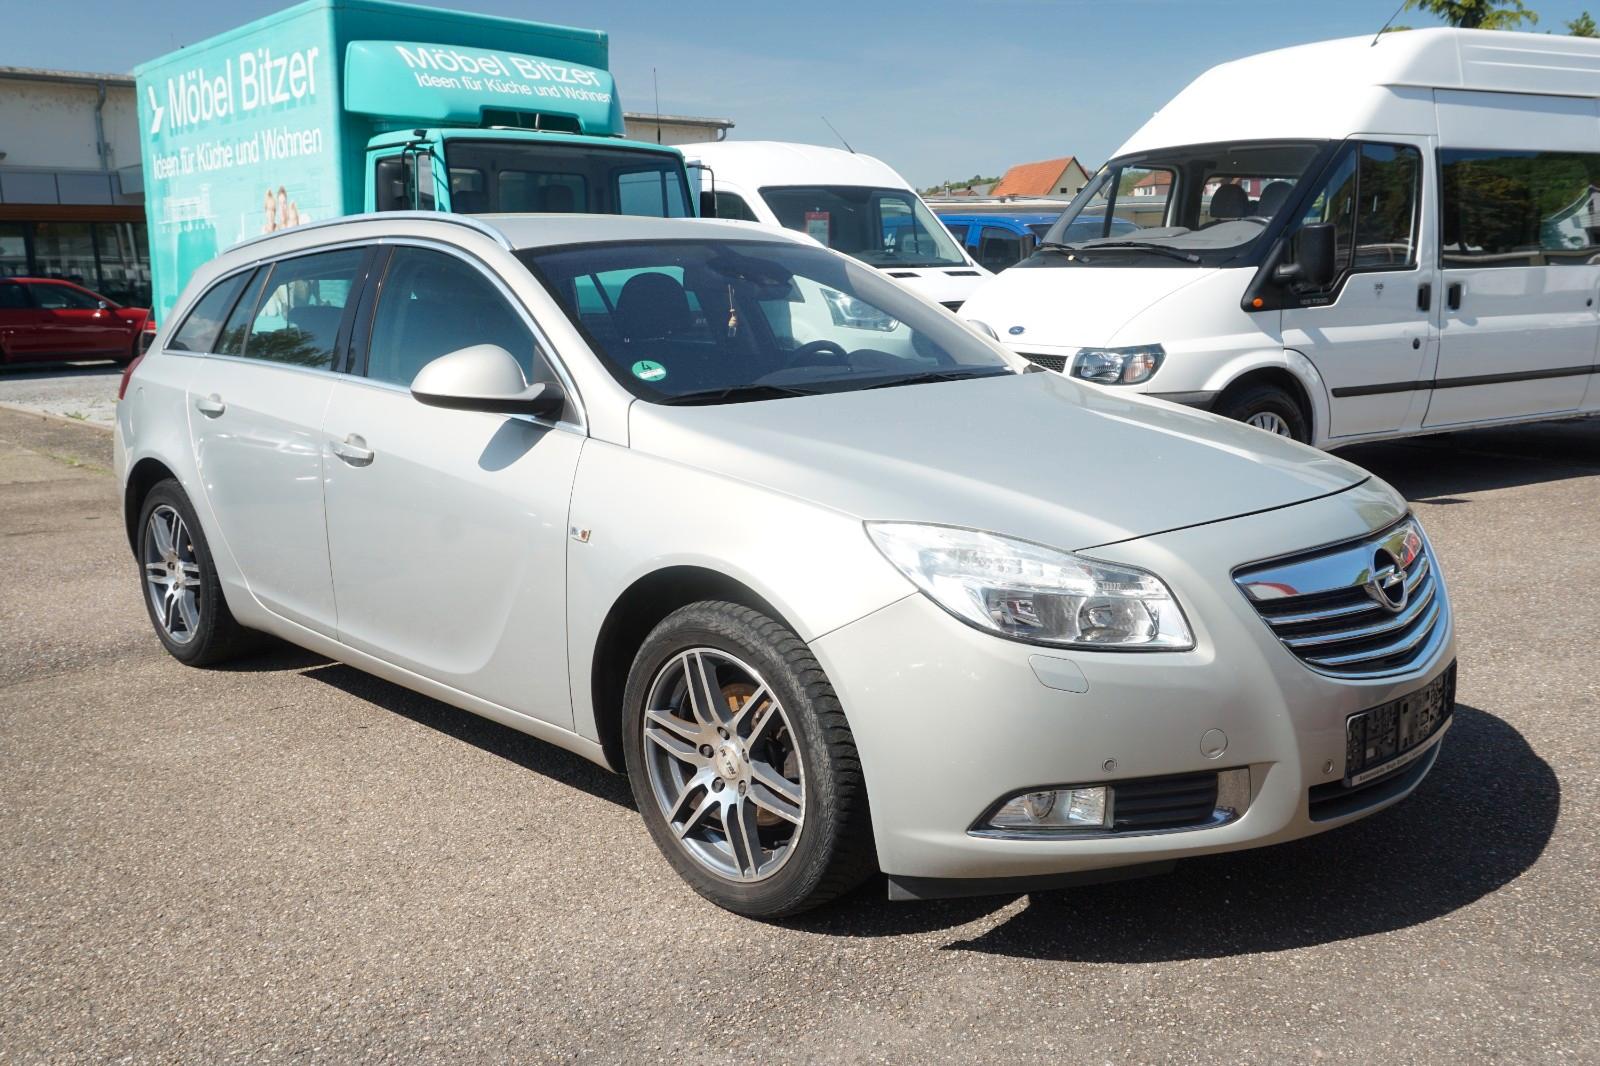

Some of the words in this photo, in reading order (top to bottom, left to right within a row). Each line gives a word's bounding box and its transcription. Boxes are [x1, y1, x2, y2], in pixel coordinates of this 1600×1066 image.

[395, 45, 511, 77] Möbel
[509, 56, 601, 87] Bitzer
[168, 58, 235, 129] Möbel
[239, 46, 319, 111] Bitzer
[414, 71, 461, 89] Ideen
[461, 76, 483, 91] für
[483, 77, 532, 96] Küche
[533, 84, 562, 98] und
[559, 87, 613, 104] Wohnen
[152, 154, 180, 180] Ideen
[180, 146, 195, 175] für
[196, 140, 233, 172] Küche
[235, 132, 260, 166] und
[262, 126, 323, 161] Wohnen
[641, 361, 652, 371] 4
